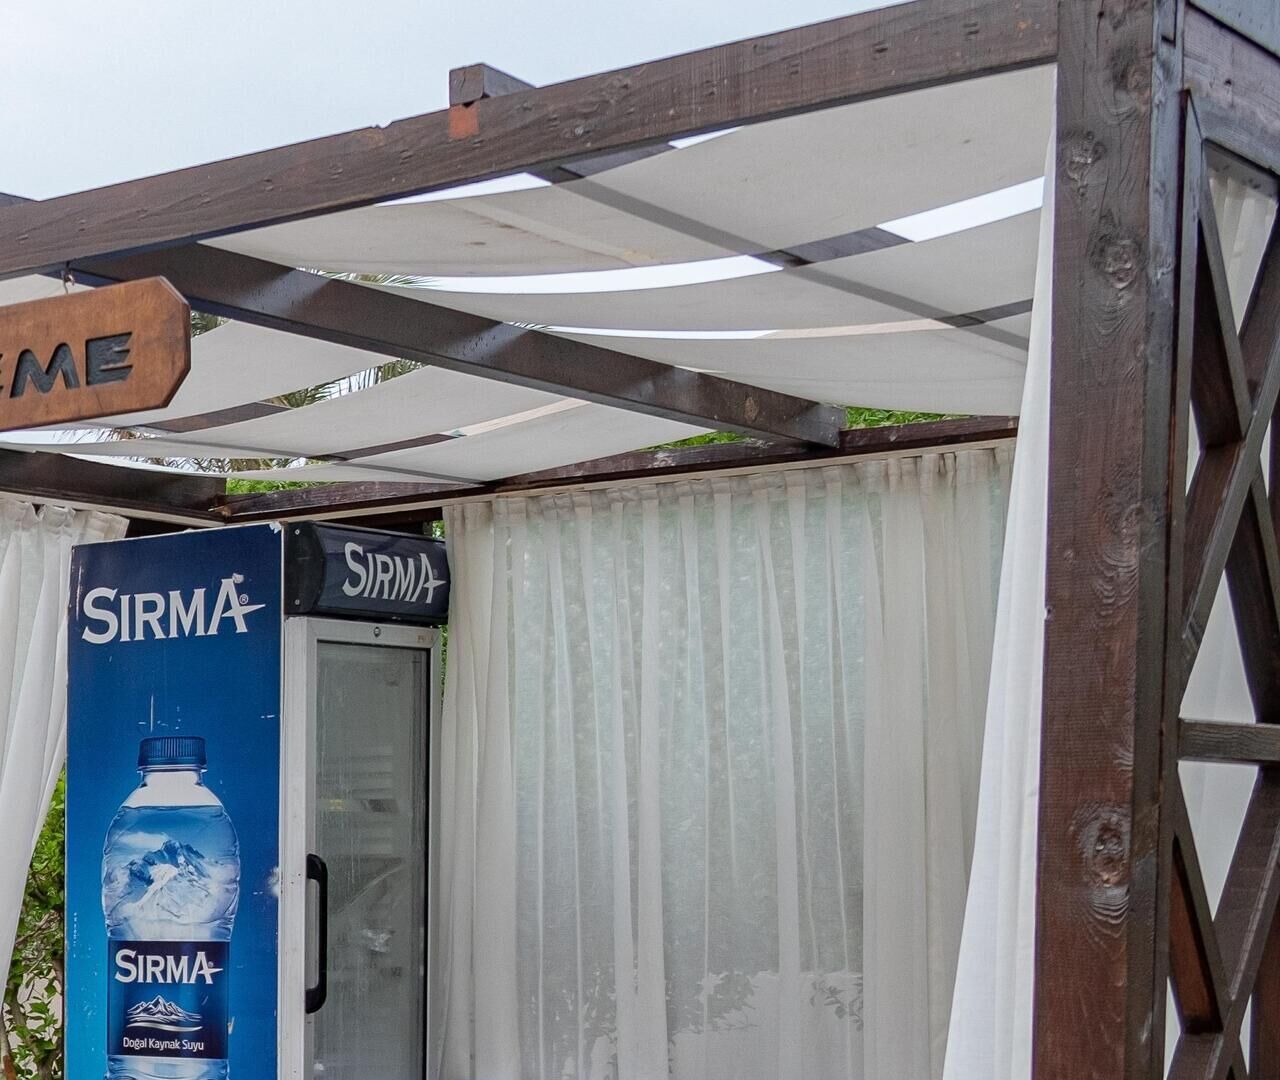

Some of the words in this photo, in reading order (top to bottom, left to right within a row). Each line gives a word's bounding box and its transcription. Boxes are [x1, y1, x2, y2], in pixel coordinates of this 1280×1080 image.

[342, 541, 447, 604] SIRMA
[81, 578, 266, 645] SIRMA
[114, 948, 224, 985] SIRMA
[122, 1036, 147, 1050] Doğal
[148, 1037, 181, 1052] Kaynak
[181, 1039, 205, 1052] Suyu
